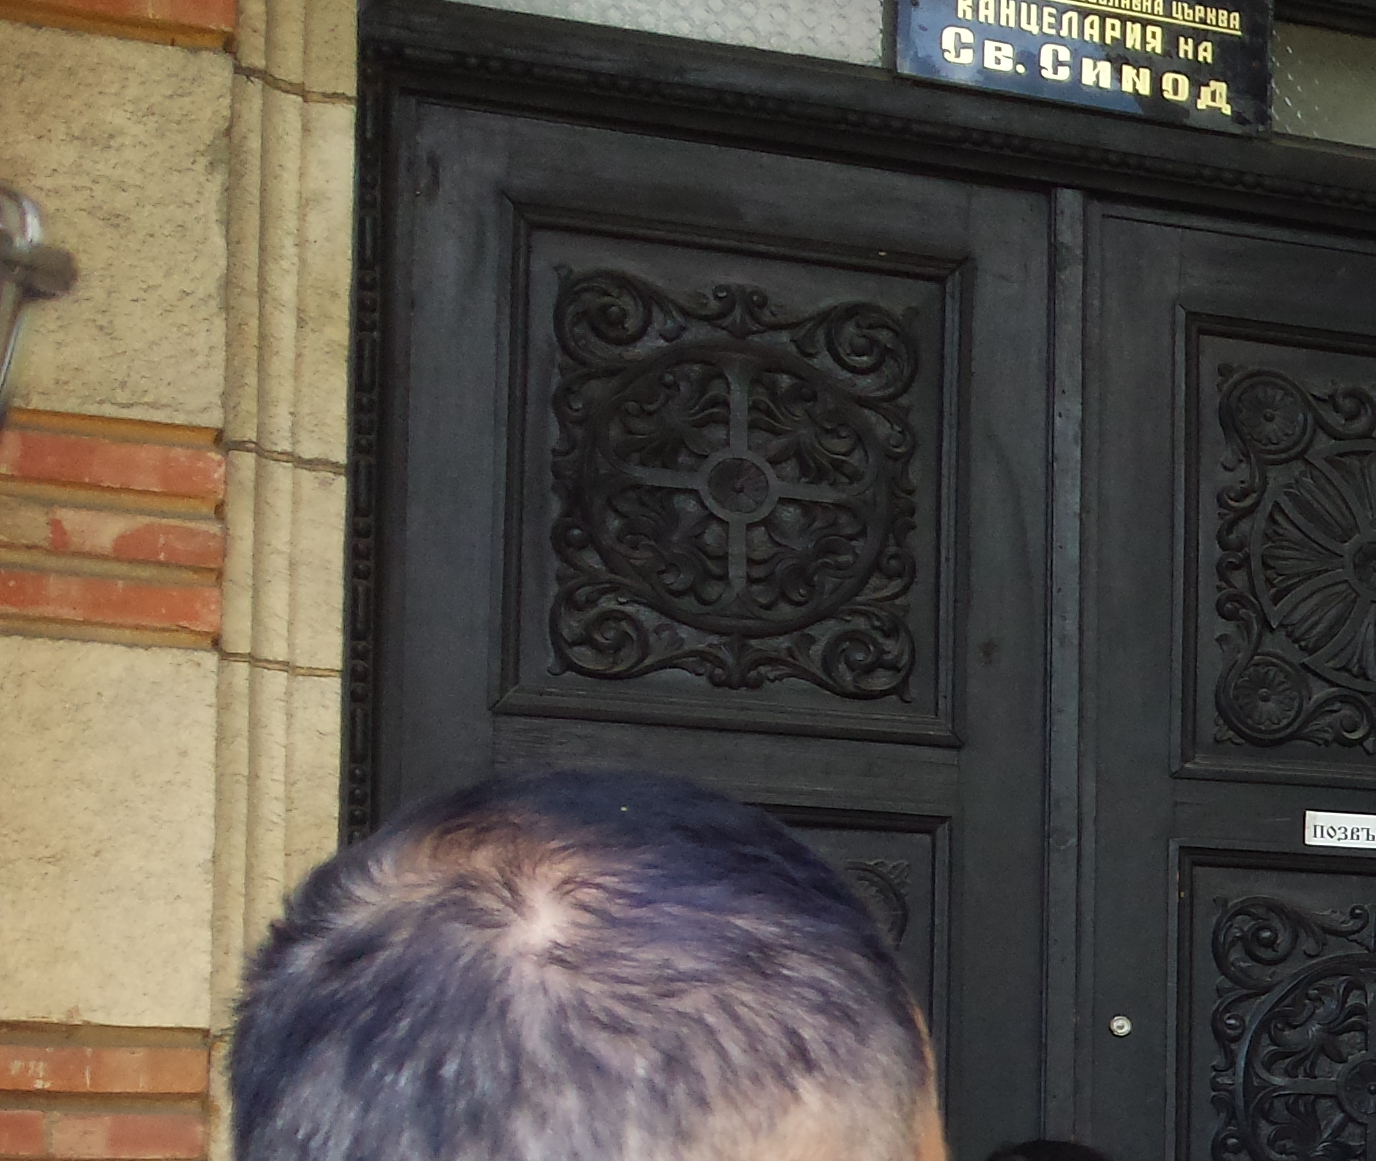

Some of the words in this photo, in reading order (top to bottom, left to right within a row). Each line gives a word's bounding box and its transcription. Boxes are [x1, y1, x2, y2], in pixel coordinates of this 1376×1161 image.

[957, 0, 1163, 54] КАНЦЕЛАРИЯ
[1178, 36, 1213, 64] НА
[1171, 1, 1241, 29] ЦЪРКВА
